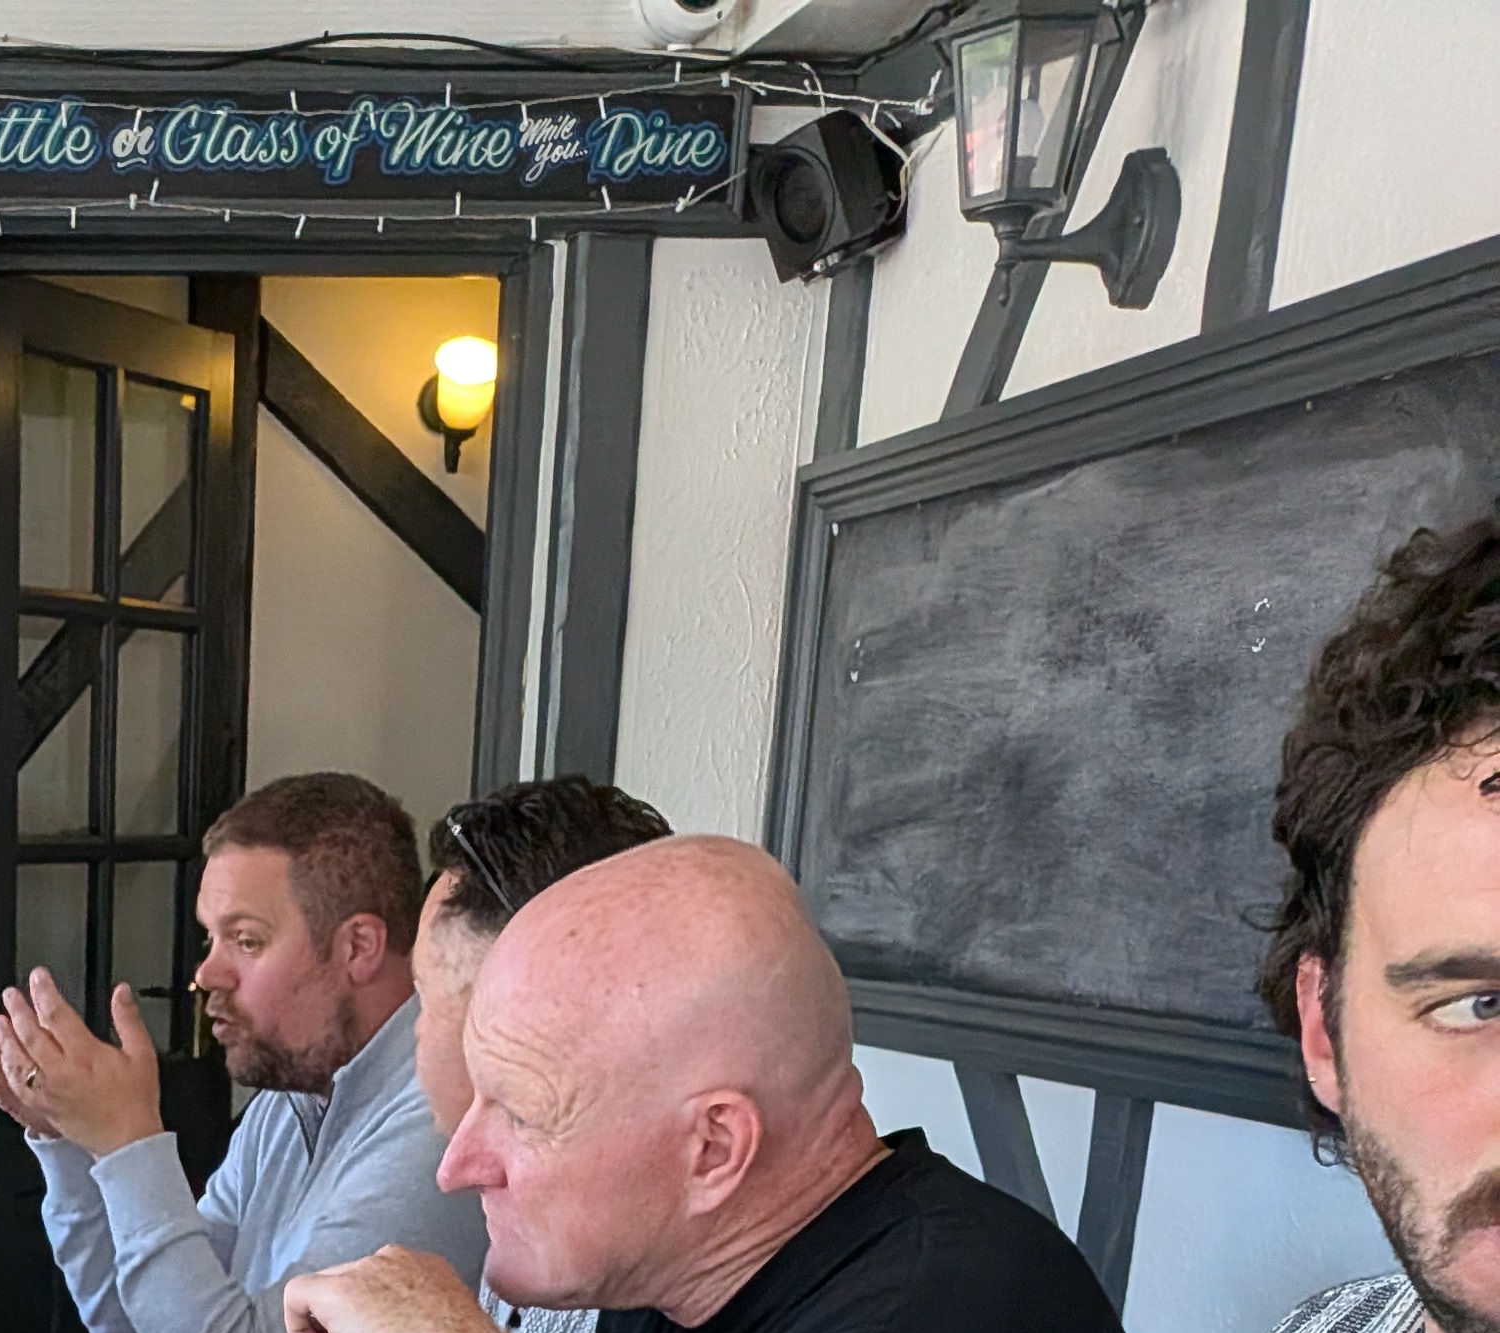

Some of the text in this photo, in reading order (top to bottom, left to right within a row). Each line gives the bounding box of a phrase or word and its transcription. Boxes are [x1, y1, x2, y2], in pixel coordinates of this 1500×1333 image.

[113, 122, 156, 162] or
[162, 102, 301, 167] Glass
[314, 100, 375, 180] of
[381, 101, 515, 170] Wine
[519, 114, 574, 152] While
[596, 110, 727, 177] Dine
